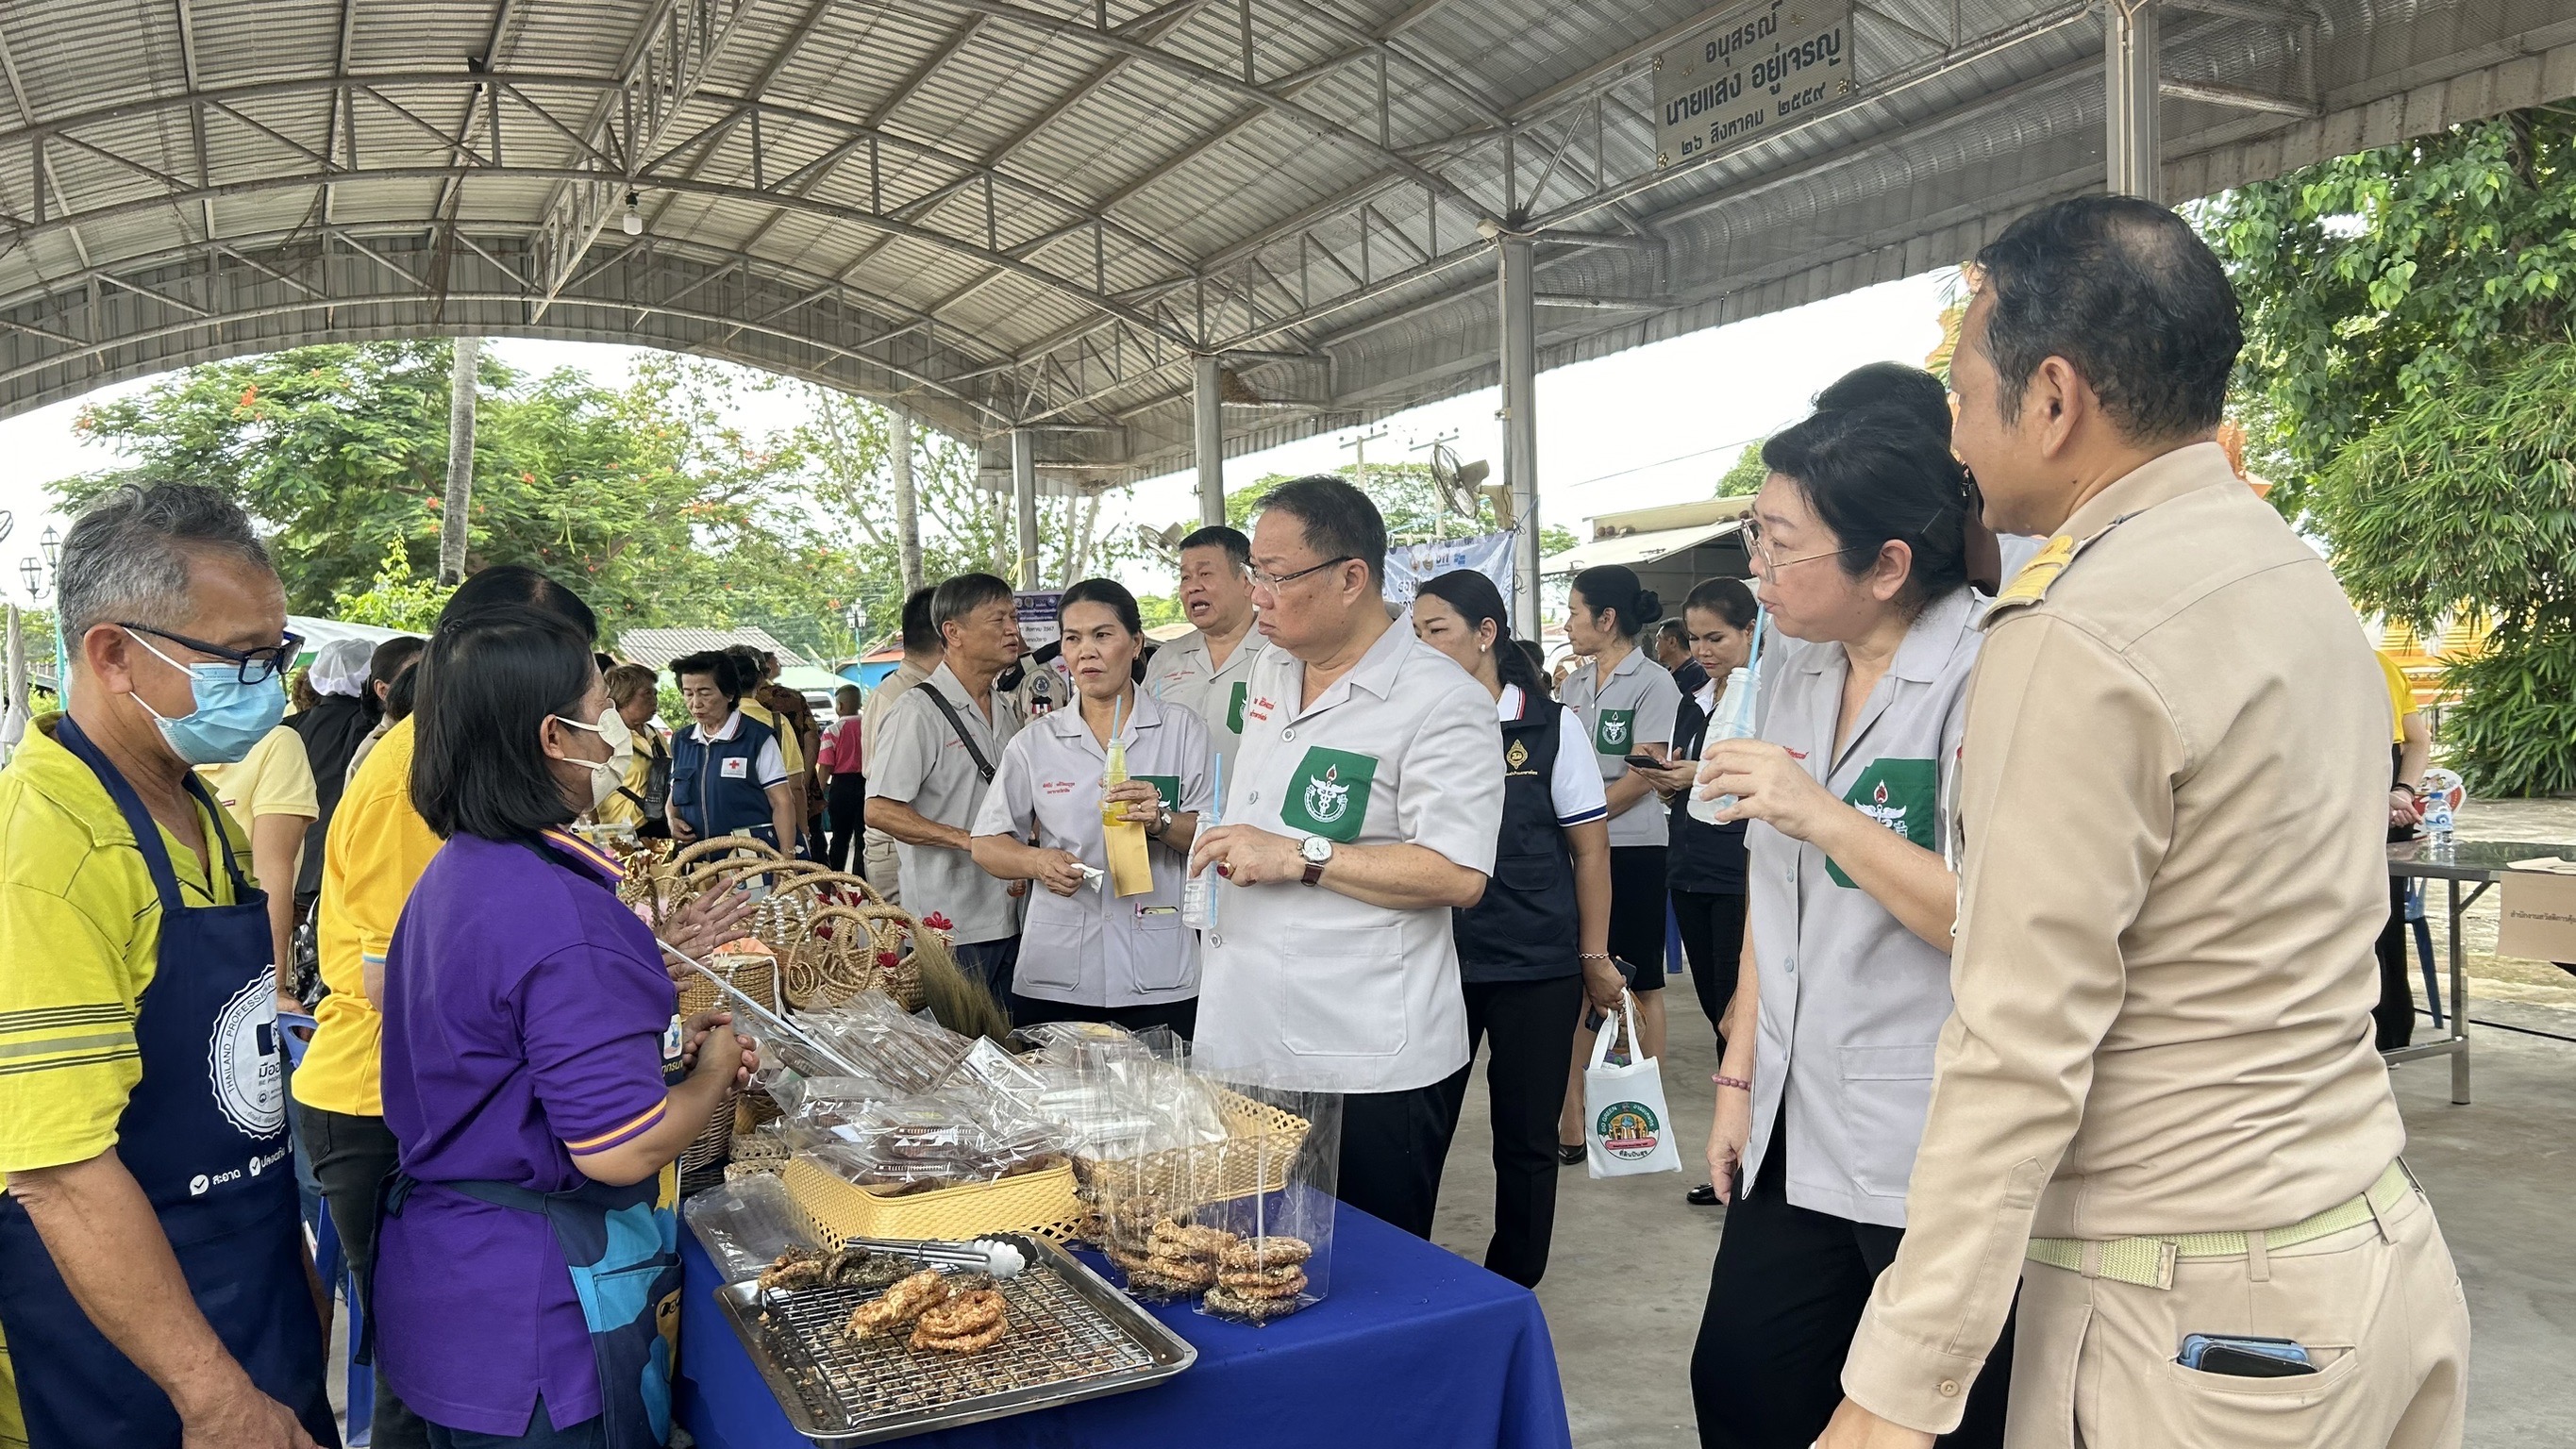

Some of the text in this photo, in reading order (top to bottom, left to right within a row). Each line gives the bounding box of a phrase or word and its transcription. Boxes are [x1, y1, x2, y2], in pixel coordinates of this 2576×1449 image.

[1705, 0, 1782, 67] อนุสรณ์
[1665, 73, 1742, 126] นายแสง
[1681, 82, 1826, 156] ๒๖ สิงหาคม ๒๕๕๙
[223, 1043, 236, 1095] THAILAND
[1601, 1106, 1618, 1132] GO GREEN
[212, 1169, 242, 1186] สะอาด
